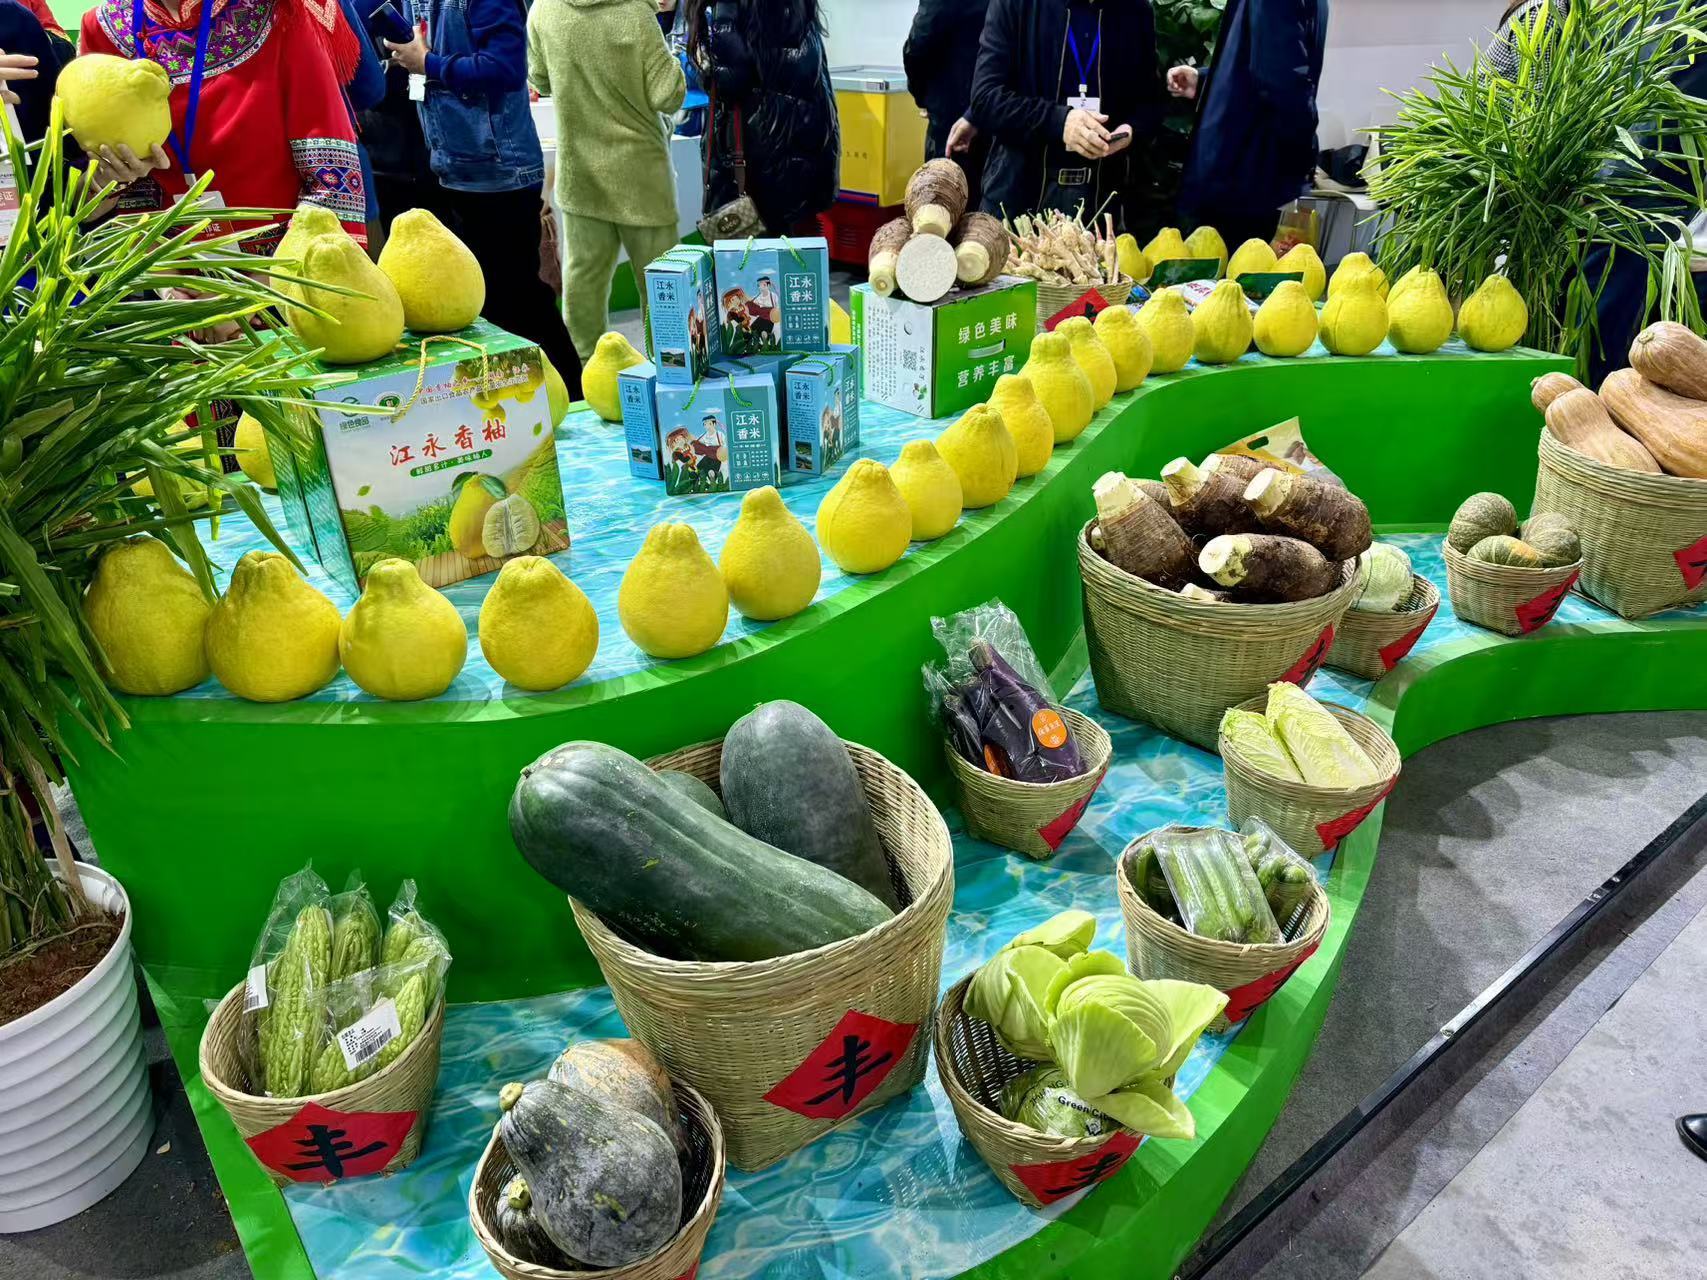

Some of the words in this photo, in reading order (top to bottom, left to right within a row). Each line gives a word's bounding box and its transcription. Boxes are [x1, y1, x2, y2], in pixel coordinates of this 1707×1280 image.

[789, 276, 812, 288] 江永
[790, 290, 813, 303] 香米
[958, 312, 1017, 344] 绿色美味
[957, 355, 1015, 388] 营养丰富
[736, 414, 760, 426] 江永
[389, 418, 506, 467] 江永香柚
[737, 427, 761, 440] 香米
[804, 1035, 893, 1105] 丰
[1058, 1096, 1089, 1114] Green
[282, 1125, 388, 1178] 丰
